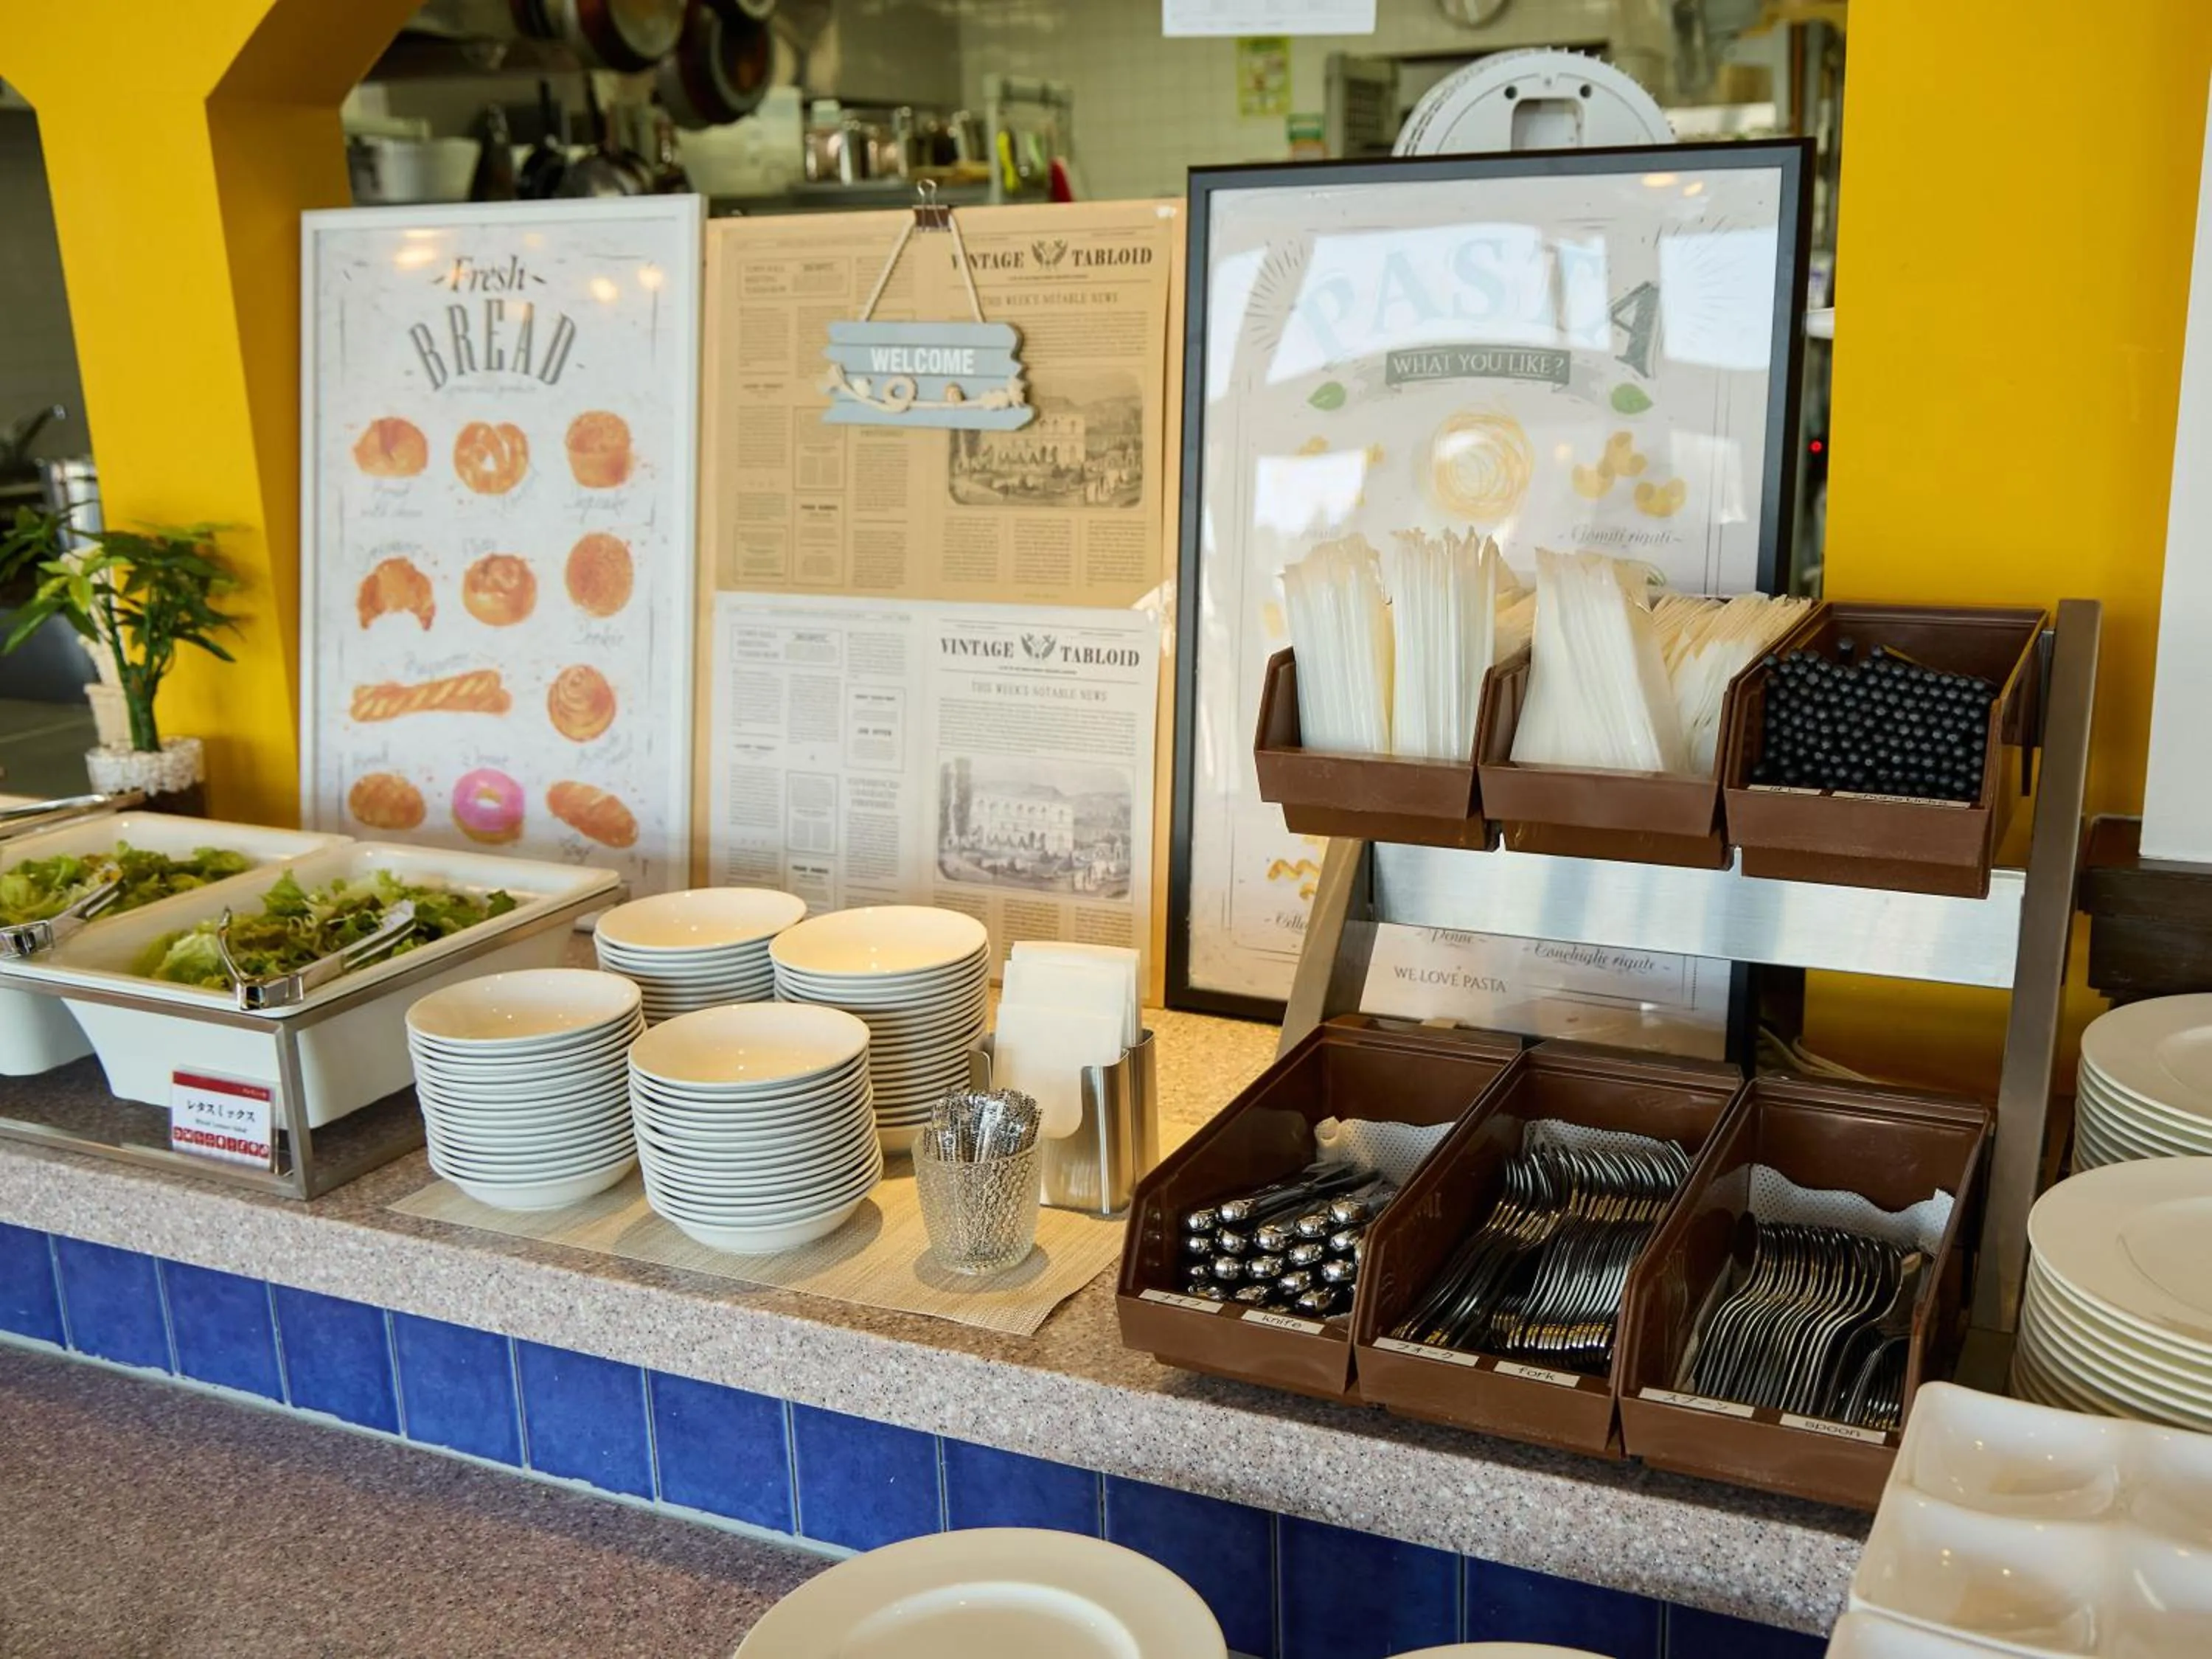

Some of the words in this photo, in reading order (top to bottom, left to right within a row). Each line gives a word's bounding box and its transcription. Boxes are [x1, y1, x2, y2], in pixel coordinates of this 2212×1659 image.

[950, 251, 1025, 270] VNTAGE
[1071, 246, 1152, 267] TABLOID
[451, 254, 524, 292] Fresh
[1301, 237, 1663, 378] PASTA
[408, 298, 577, 392] BREAD
[870, 347, 975, 375] WELCOME
[1393, 354, 1451, 374] WHAT
[1458, 352, 1502, 372] YOU
[941, 637, 1015, 659] VINTAGE
[1060, 646, 1141, 667] TABLOID
[1394, 965, 1418, 981] WE
[1421, 968, 1459, 988] LOVE
[1463, 975, 1507, 994] PASTA
[1262, 1315, 1302, 1328] knife
[1517, 1366, 1556, 1381] fork
[1805, 1420, 1861, 1437] spoon
